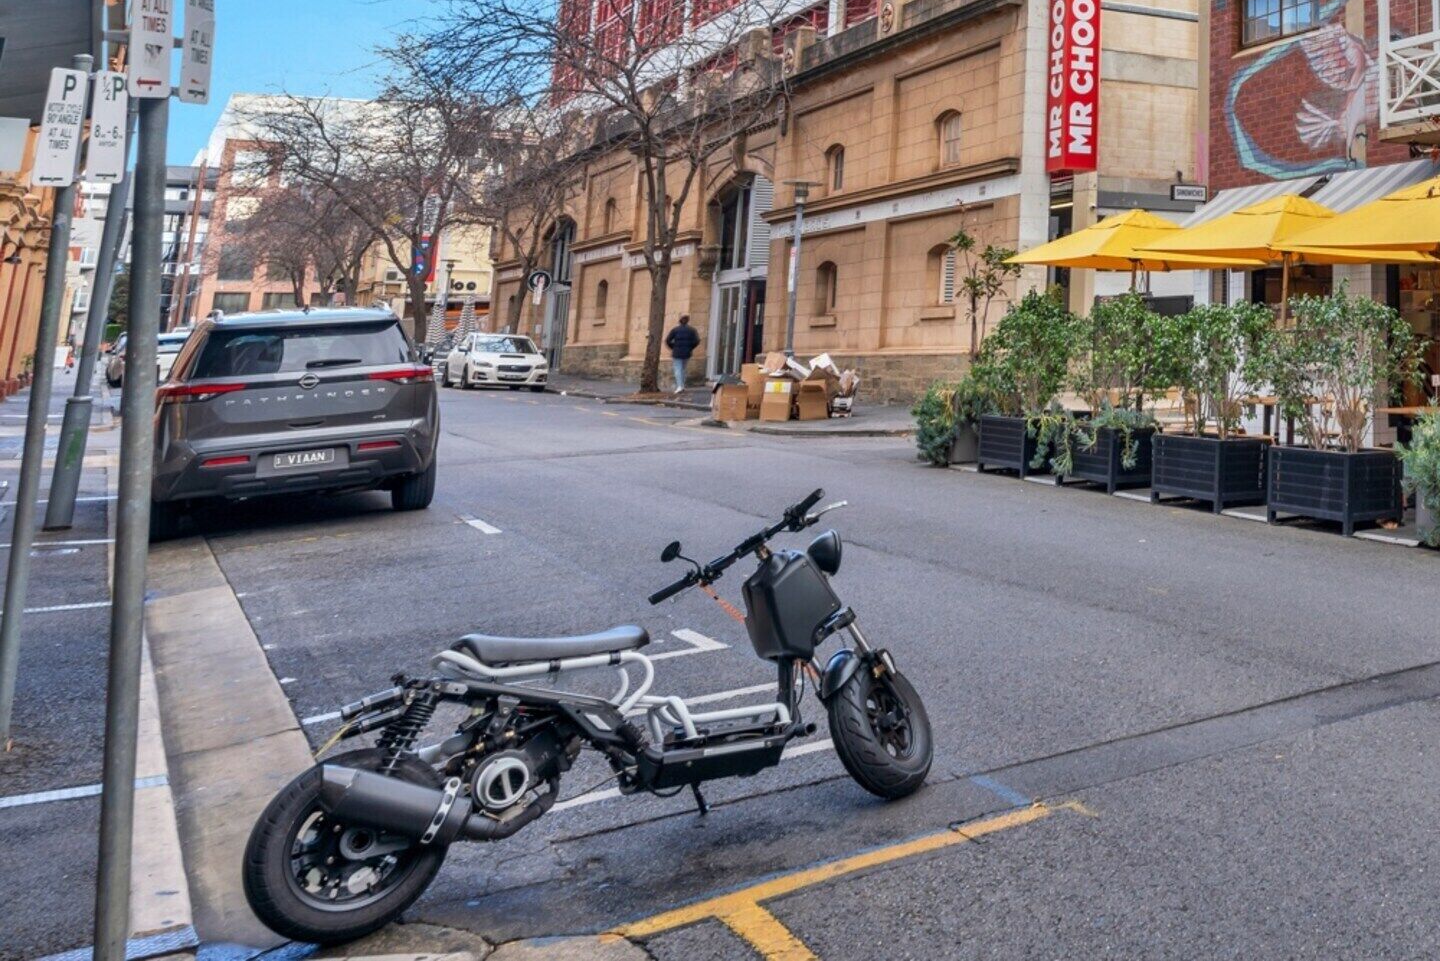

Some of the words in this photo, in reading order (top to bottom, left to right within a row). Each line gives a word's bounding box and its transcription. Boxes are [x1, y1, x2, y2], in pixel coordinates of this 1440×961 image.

[142, 15, 166, 33] TIMES
[62, 74, 77, 101] P
[48, 128, 58, 138] AT
[60, 129, 72, 139] ALL
[1050, 105, 1062, 158] MR
[1068, 101, 1093, 154] MR
[48, 139, 70, 150] TIMES
[225, 387, 386, 407] PATHFINDER
[288, 451, 325, 465] VIAAN
